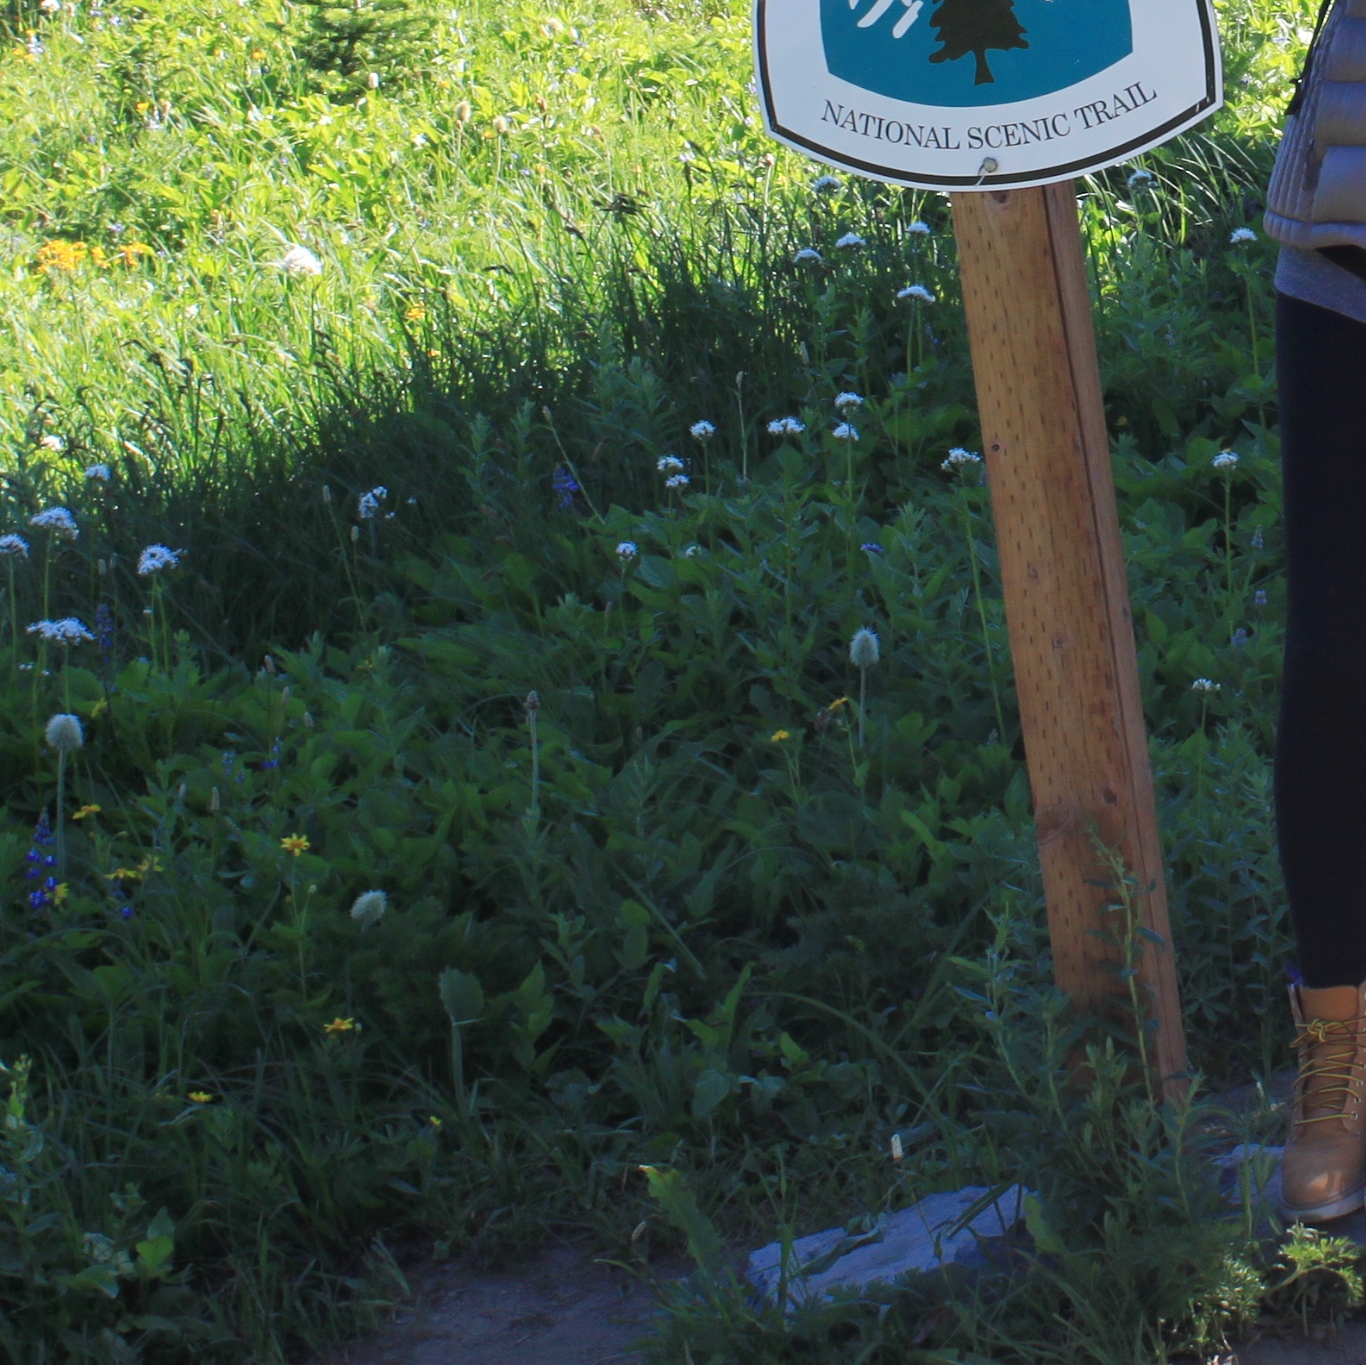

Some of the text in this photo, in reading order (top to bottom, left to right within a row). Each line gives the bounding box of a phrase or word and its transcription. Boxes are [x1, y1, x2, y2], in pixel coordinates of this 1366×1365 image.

[821, 81, 1158, 150] NATIONAL SCENIC TRAIL
